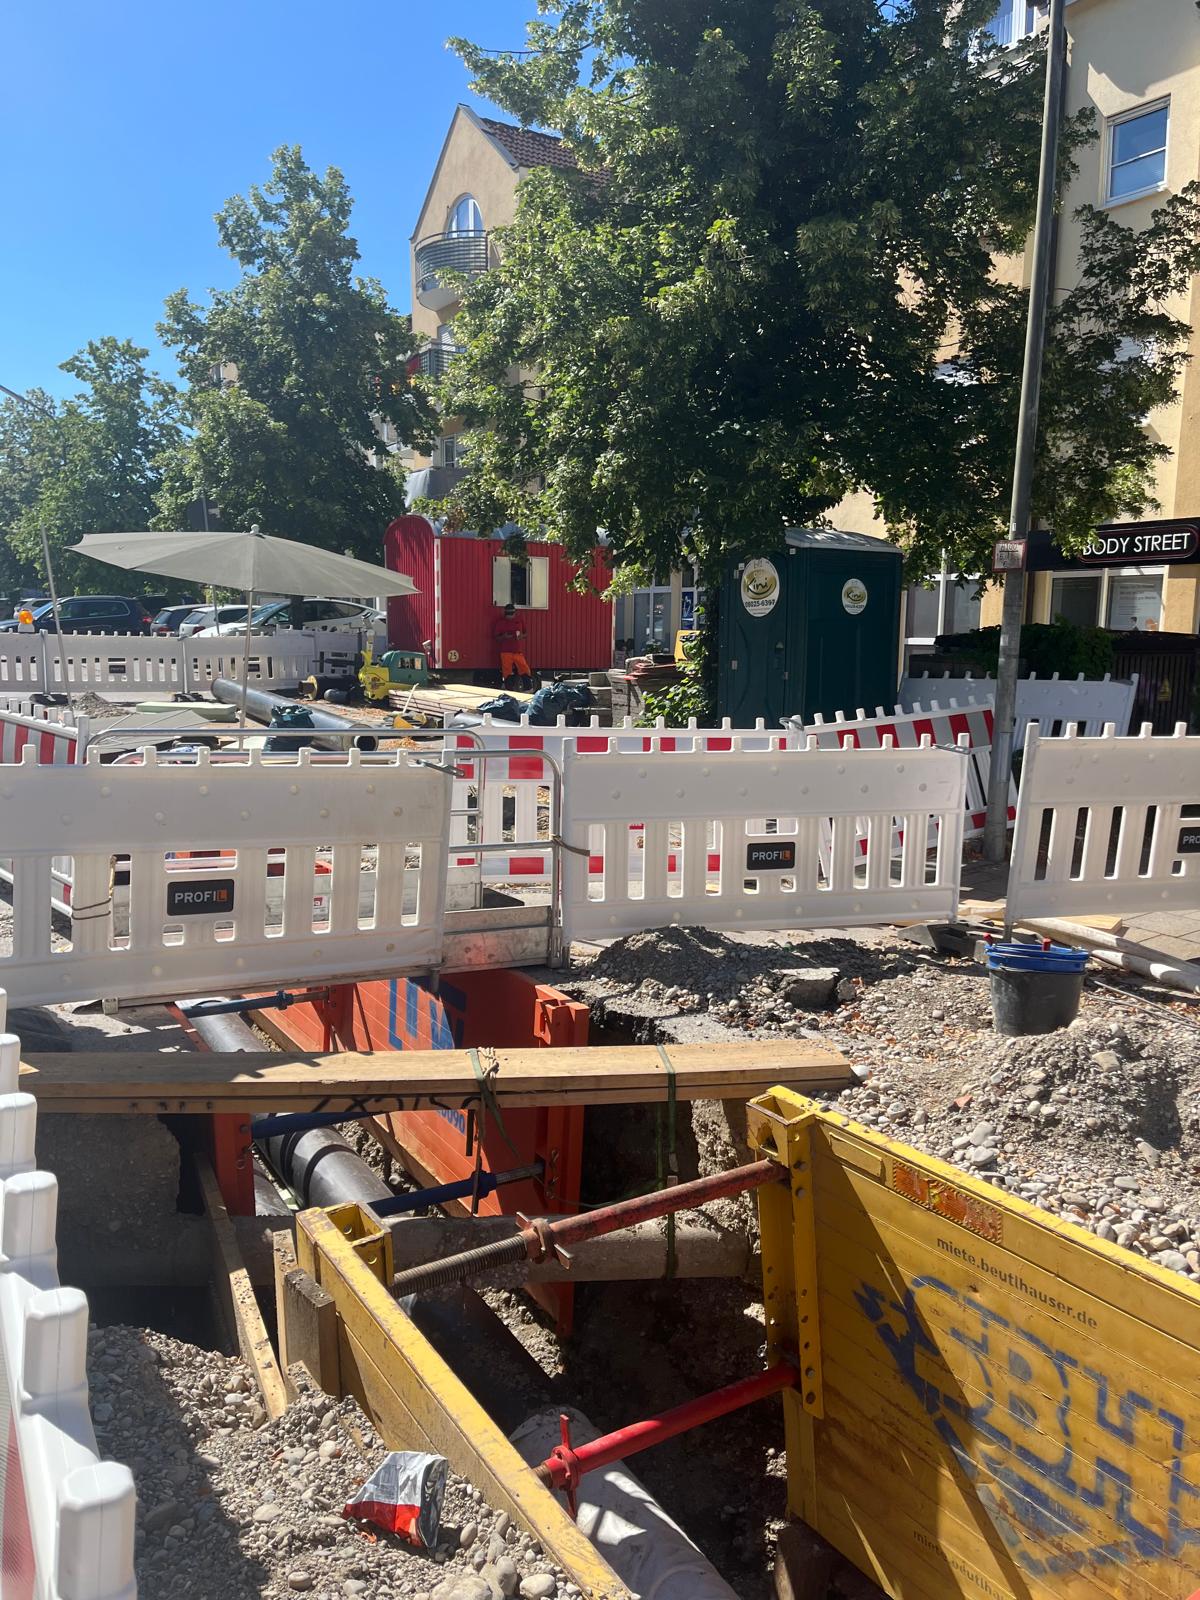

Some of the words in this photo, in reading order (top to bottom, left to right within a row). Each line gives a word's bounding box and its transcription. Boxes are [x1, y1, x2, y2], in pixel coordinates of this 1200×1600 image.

[1083, 537, 1130, 555] BODY
[1134, 533, 1190, 552] STREET
[746, 577, 772, 595] Kini
[174, 888, 228, 904] PROFIL
[937, 1238, 1098, 1330] miete.beutlhauser.de
